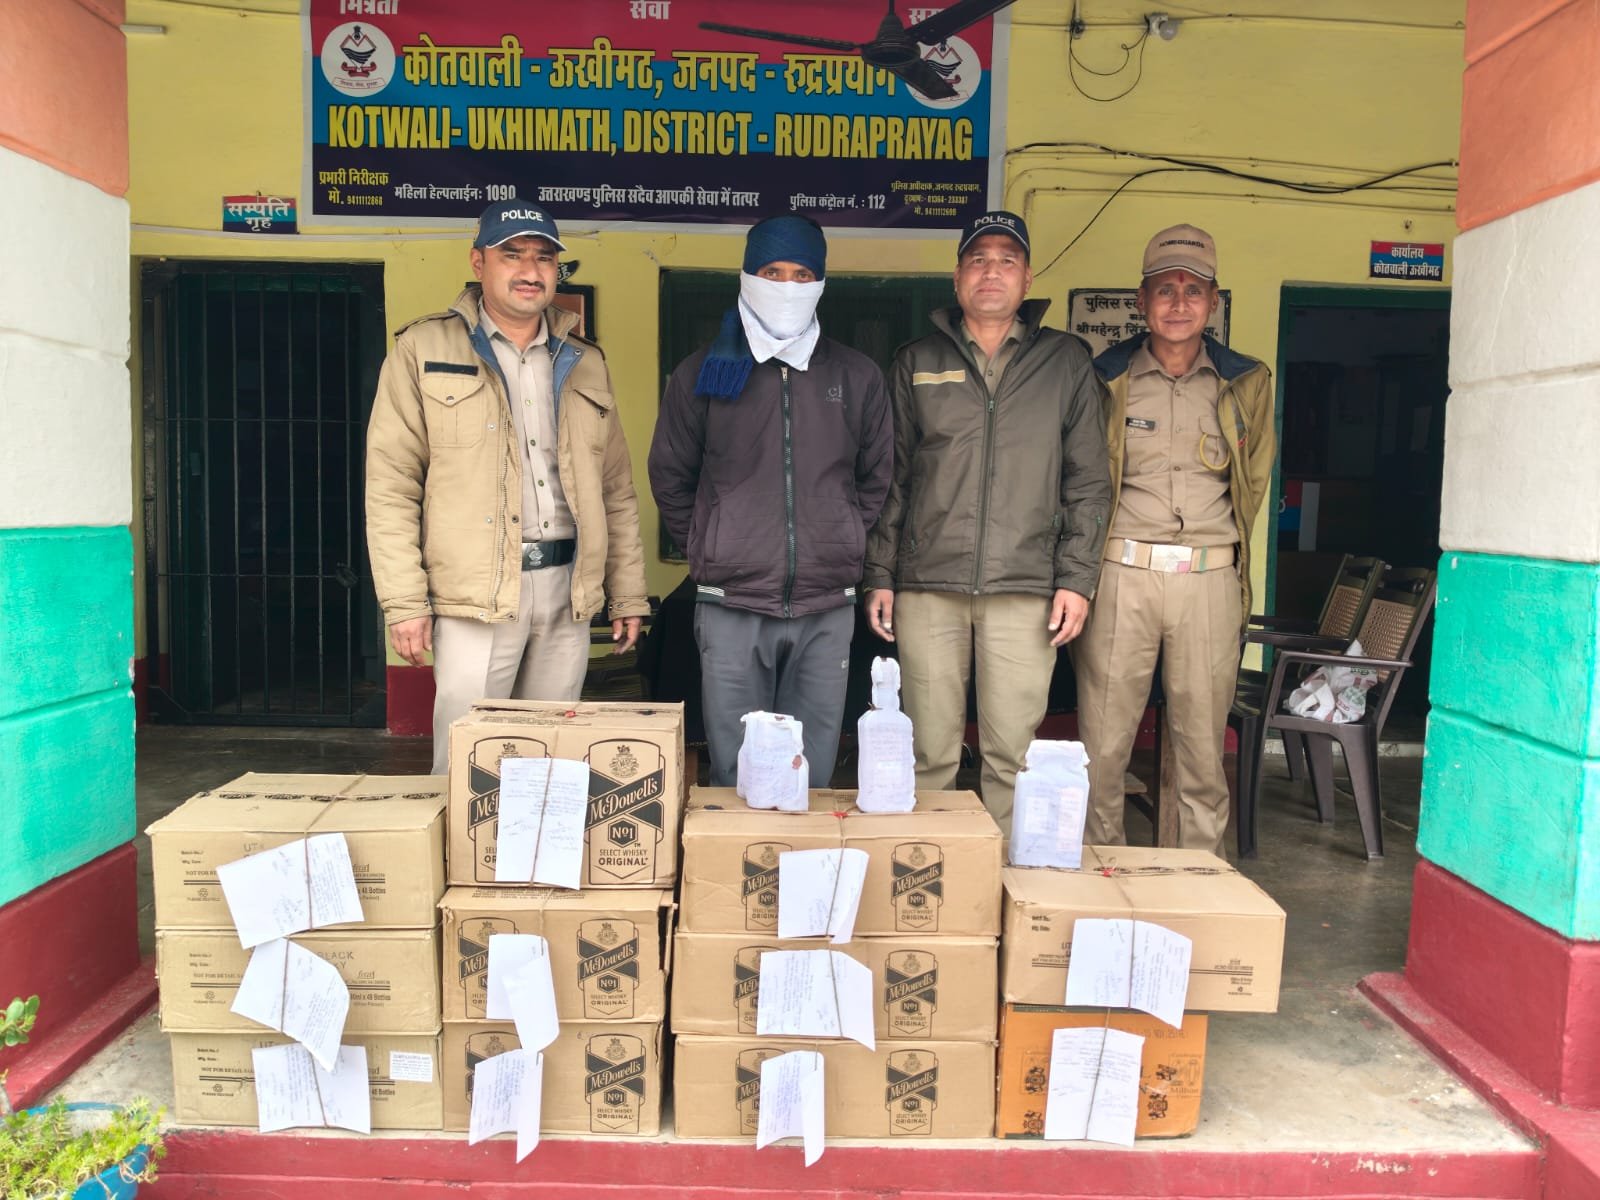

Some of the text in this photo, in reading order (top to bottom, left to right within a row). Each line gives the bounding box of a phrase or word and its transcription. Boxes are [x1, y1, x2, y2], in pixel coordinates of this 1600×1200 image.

[402, 33, 524, 88] कोतवाली
[672, 51, 759, 92] जनपद
[623, 110, 752, 155] DISTRICT
[775, 113, 973, 161] RUDRAPRAYAG
[319, 168, 389, 186] प्रभारी निरीक्षक
[394, 183, 427, 199] महिला
[485, 184, 516, 201] 1090
[592, 184, 626, 208] पुलिस
[627, 185, 654, 204] सदैव
[655, 186, 694, 205] आपकी
[696, 186, 719, 206] सेवा
[720, 187, 732, 206] में
[732, 191, 760, 207] तत्पर
[790, 193, 817, 210] पुलिस
[867, 194, 886, 209] 112
[501, 209, 544, 221] POLICE
[974, 215, 1016, 228] POLICE
[244, 217, 273, 232] गृह
[1374, 260, 1408, 276] कोतवाली
[1084, 295, 1121, 312] पुलिस
[589, 777, 658, 825] McDowell's
[600, 849, 647, 857] SELECT WHISKY
